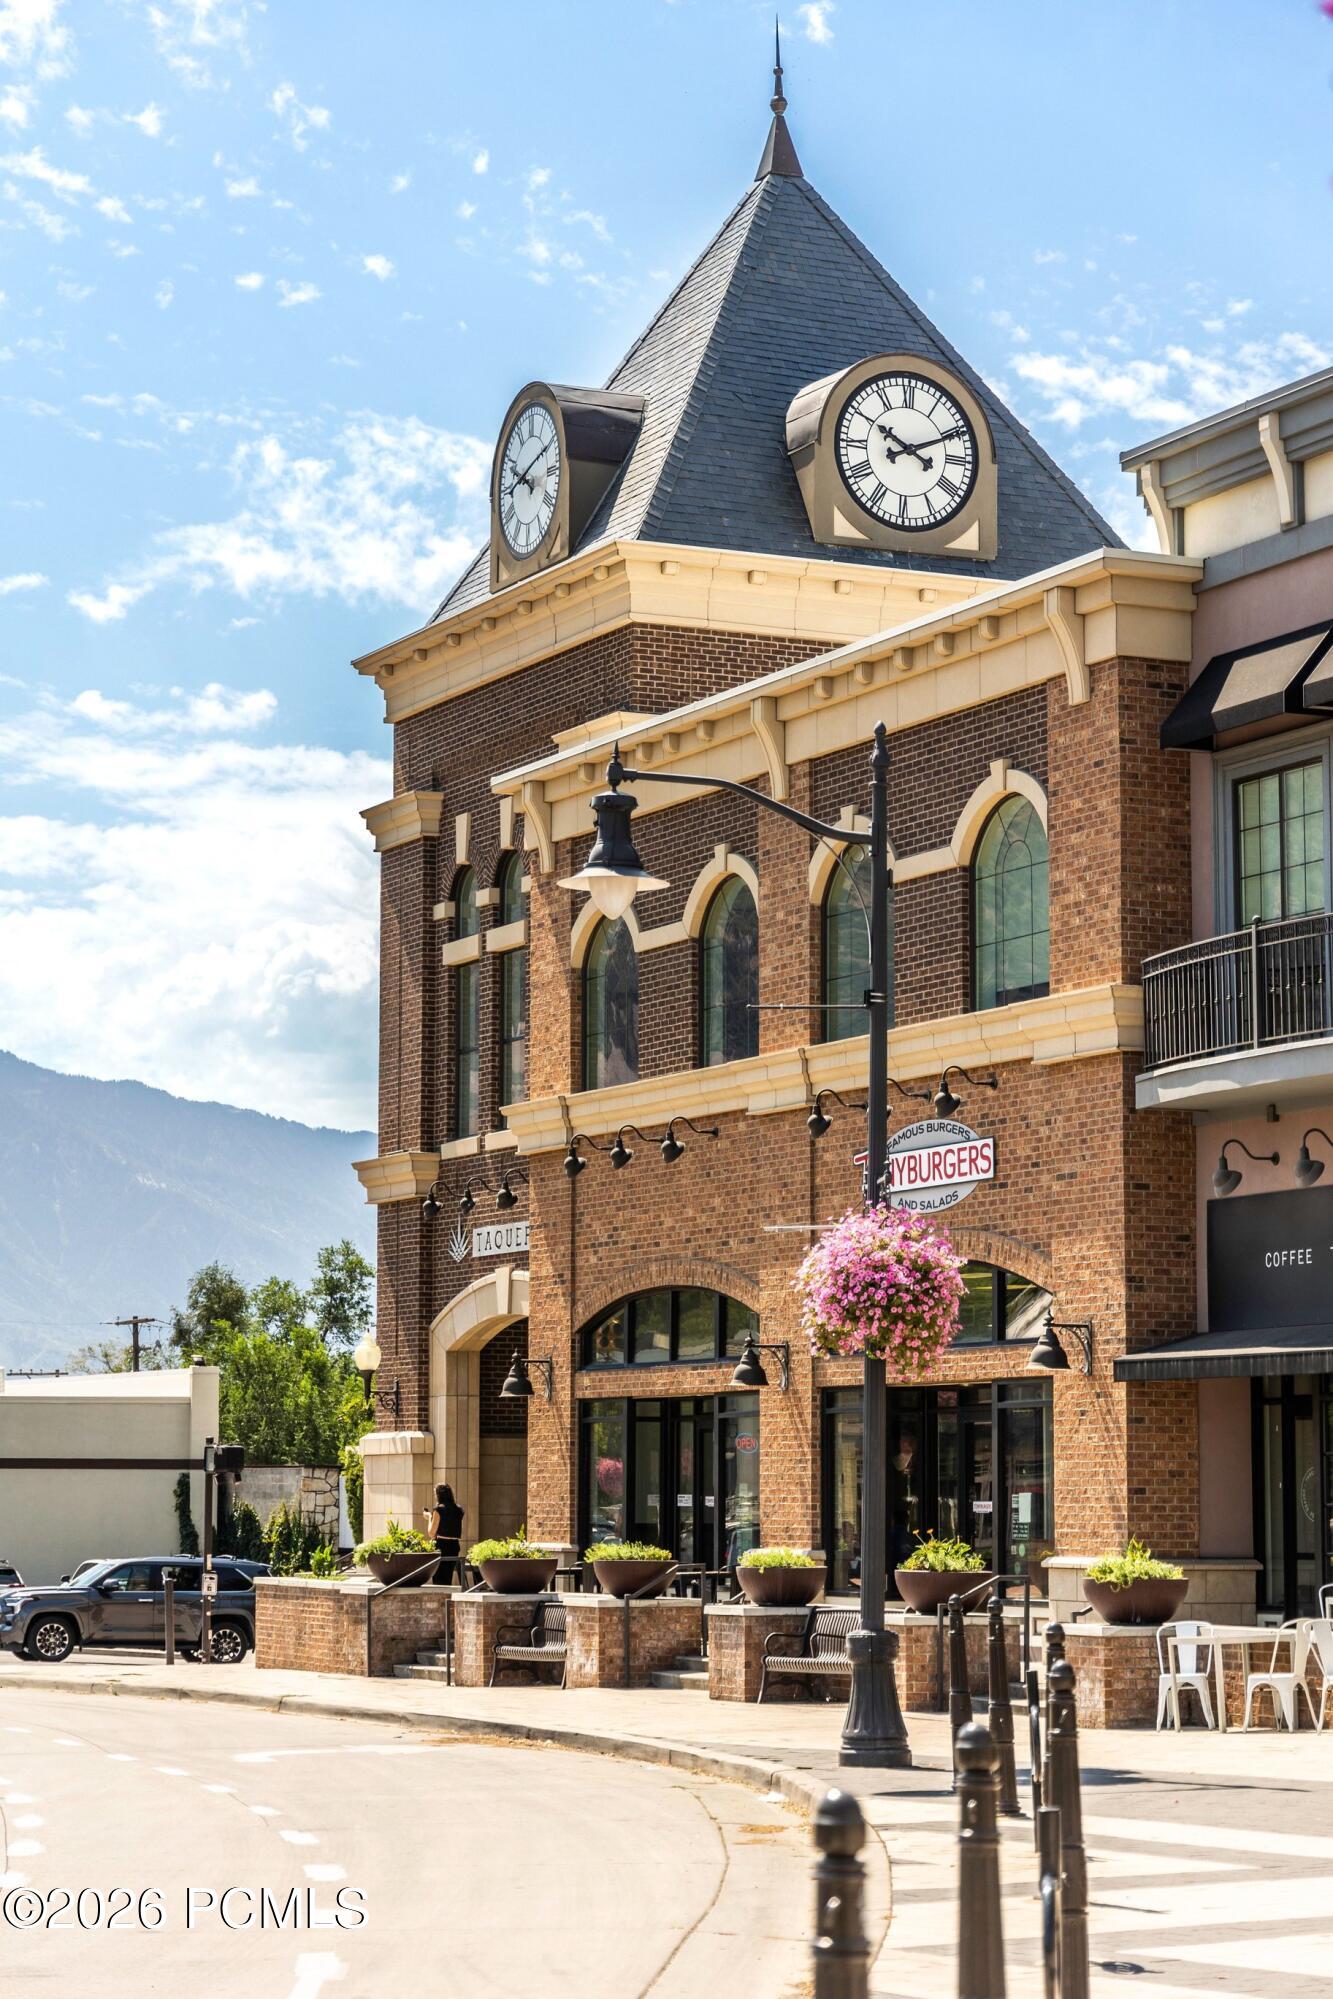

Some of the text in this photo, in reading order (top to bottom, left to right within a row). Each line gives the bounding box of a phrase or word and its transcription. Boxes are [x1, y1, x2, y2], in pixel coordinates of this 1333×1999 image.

[887, 1122, 971, 1150] FAMOUS BURGERS
[897, 1190, 959, 1211] AND SALADS
[1265, 1248, 1312, 1268] COFFEE
